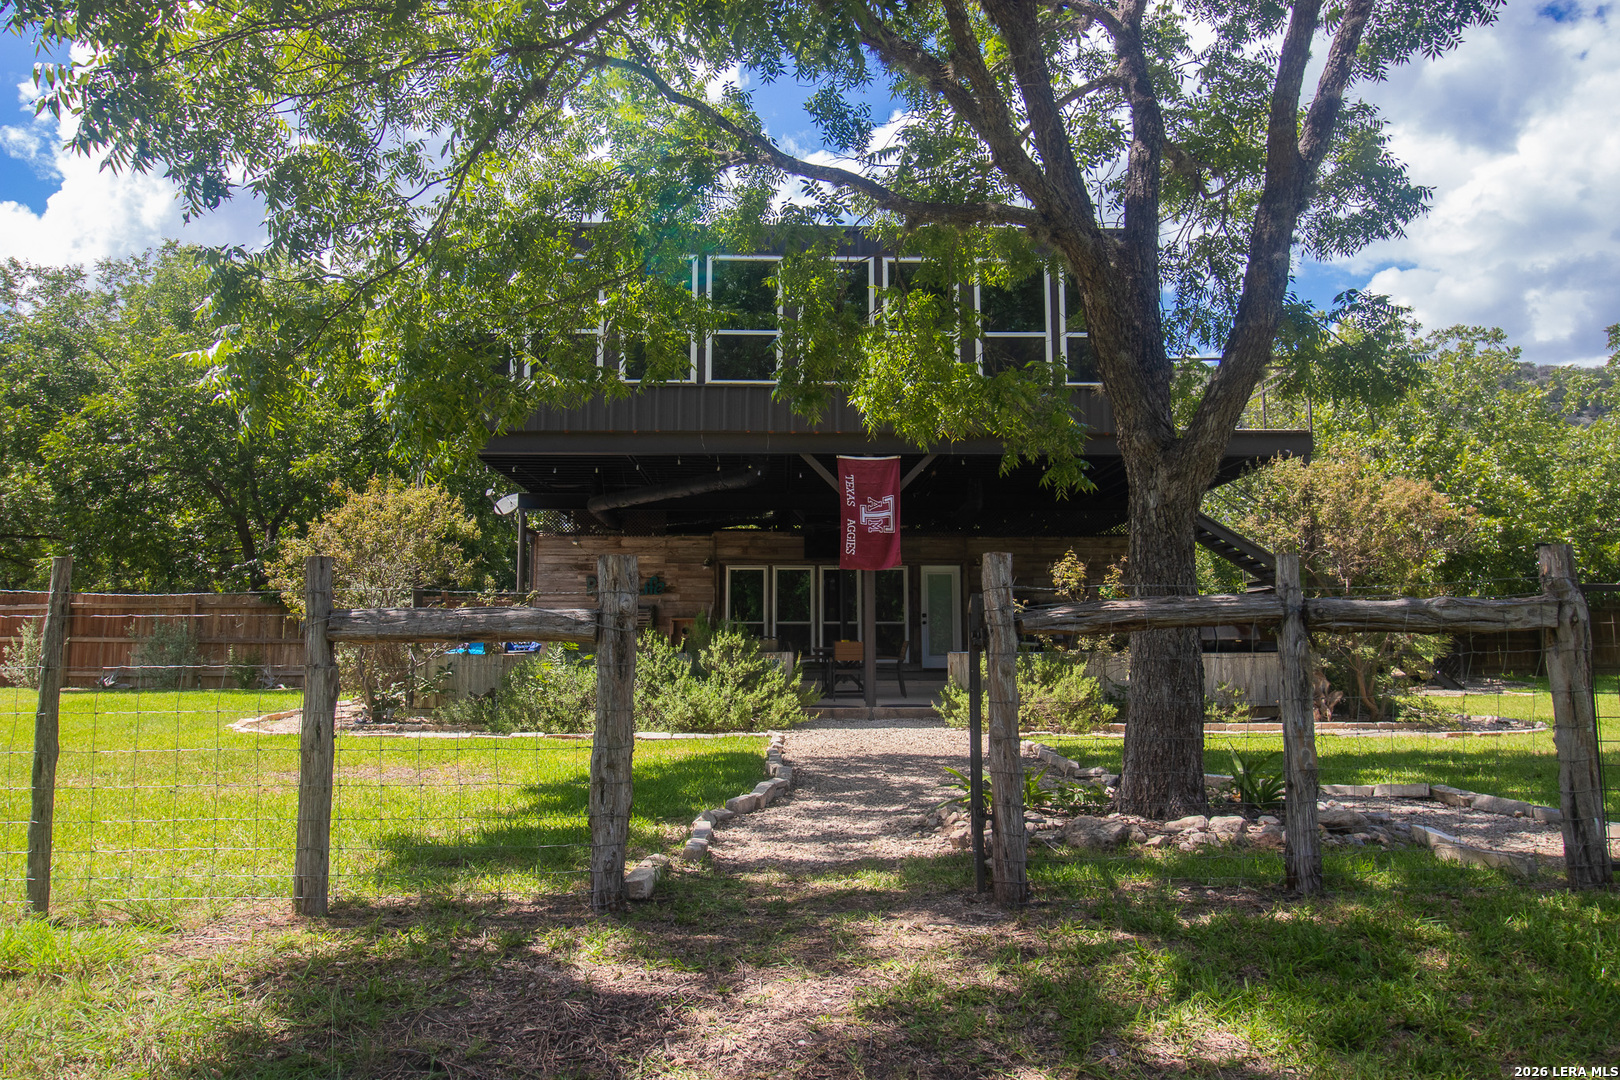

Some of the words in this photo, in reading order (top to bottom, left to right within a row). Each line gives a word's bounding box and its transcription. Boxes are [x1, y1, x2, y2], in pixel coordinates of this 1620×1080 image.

[845, 474, 856, 507] TEXAS
[845, 518, 856, 556] AGGIES
[639, 575, 665, 596] ife
